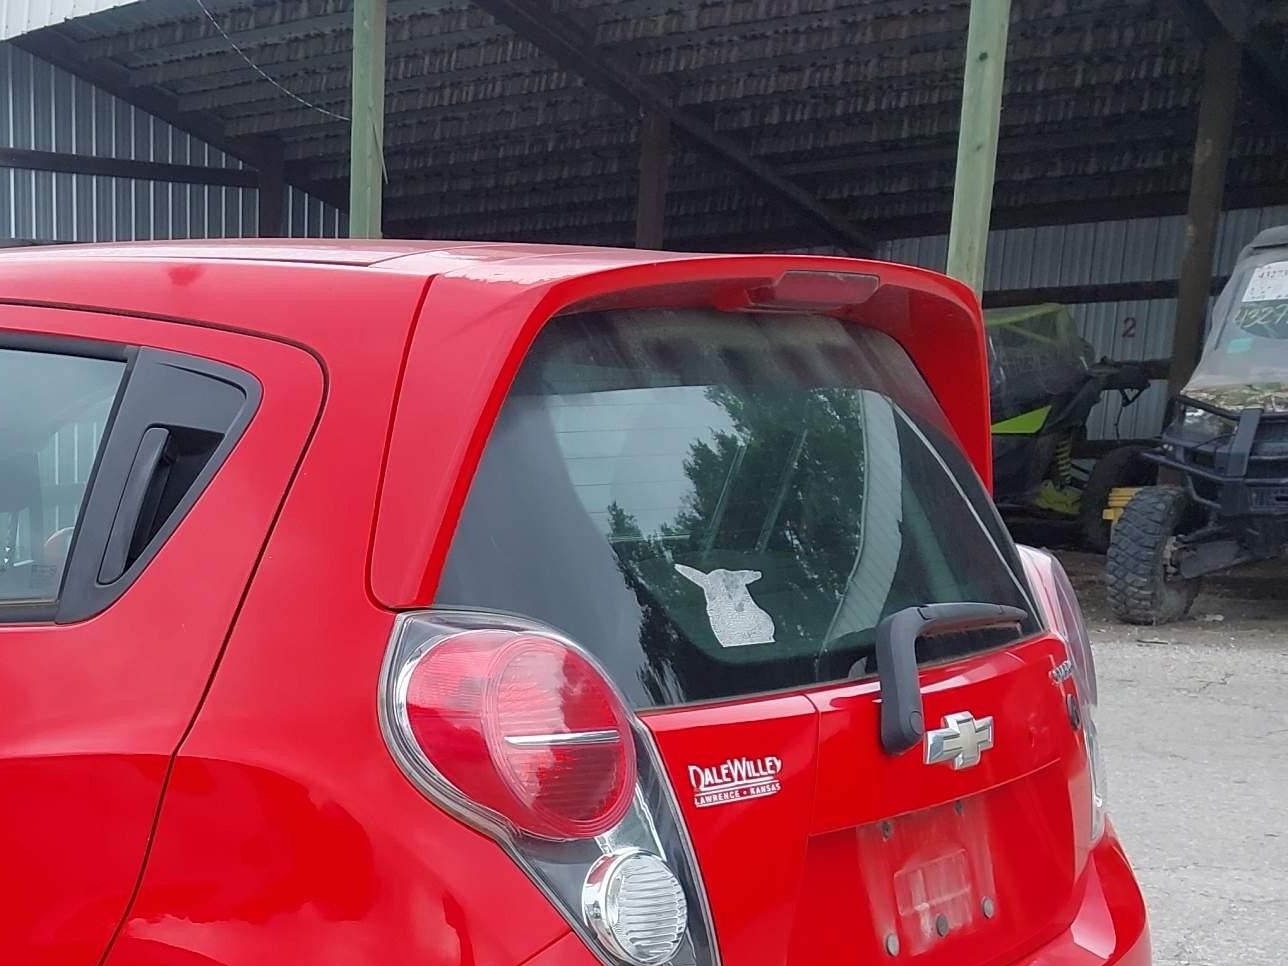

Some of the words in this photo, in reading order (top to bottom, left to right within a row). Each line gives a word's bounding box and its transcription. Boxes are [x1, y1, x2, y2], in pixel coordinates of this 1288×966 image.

[1234, 303, 1288, 328] 4327
[1122, 317, 1137, 338] 2
[694, 790, 740, 805] LAWRENCE
[750, 783, 781, 795] KANSAS
